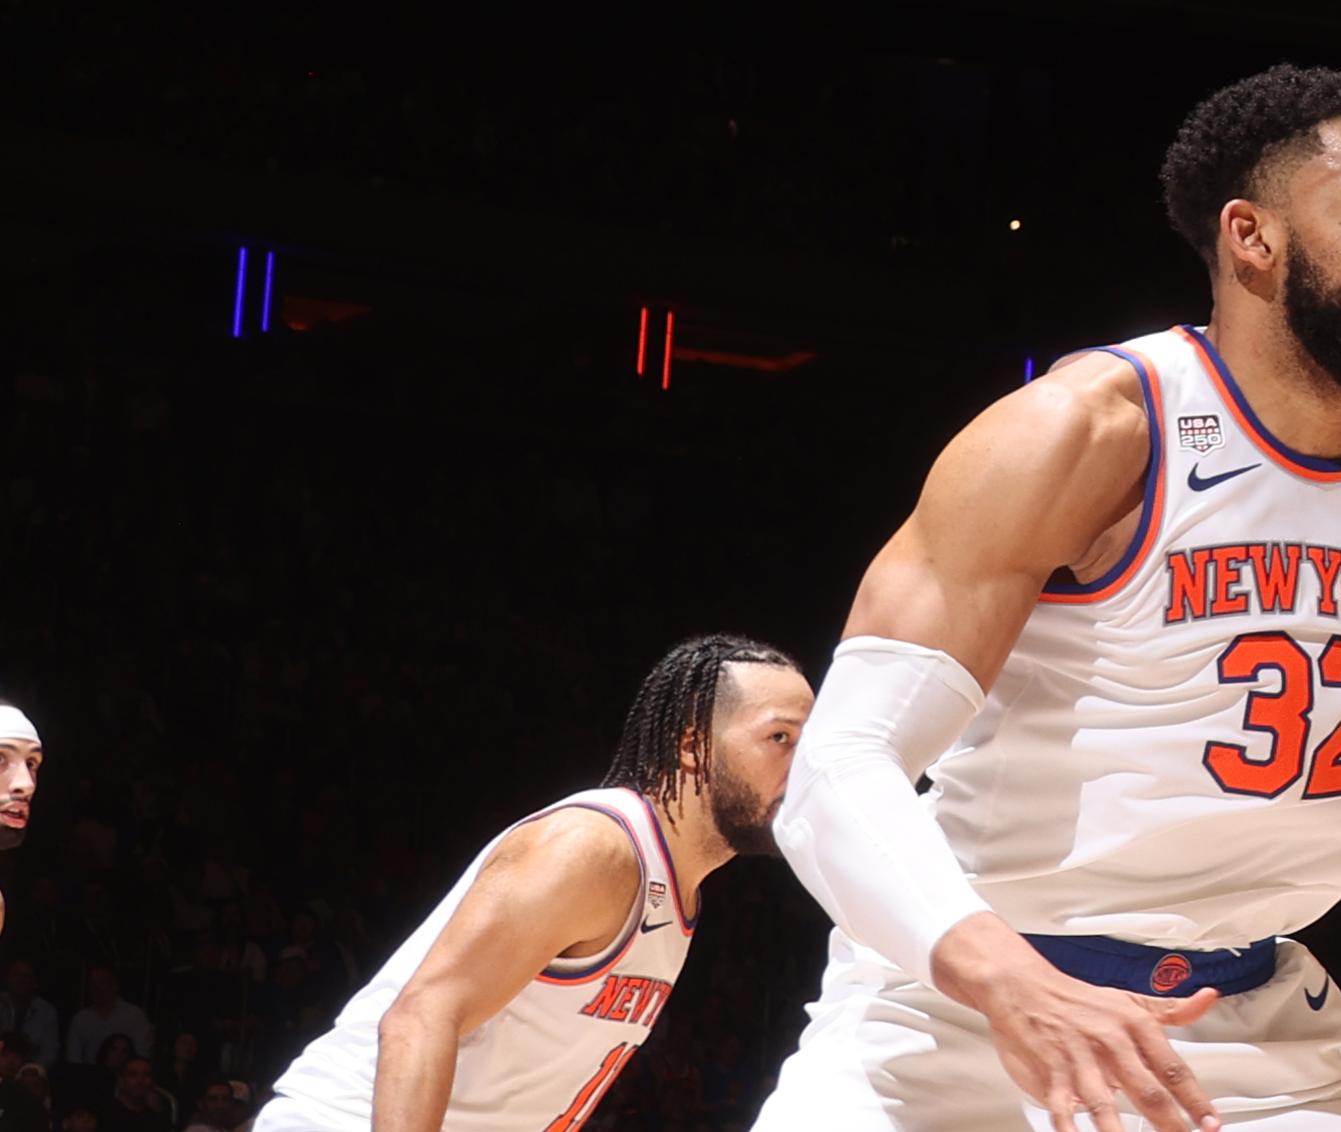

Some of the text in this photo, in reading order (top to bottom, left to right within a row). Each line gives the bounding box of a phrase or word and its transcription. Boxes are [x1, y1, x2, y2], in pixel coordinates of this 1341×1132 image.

[1180, 418, 1217, 429] USA
[1181, 433, 1220, 446] 250
[1163, 540, 1301, 627] NEW
